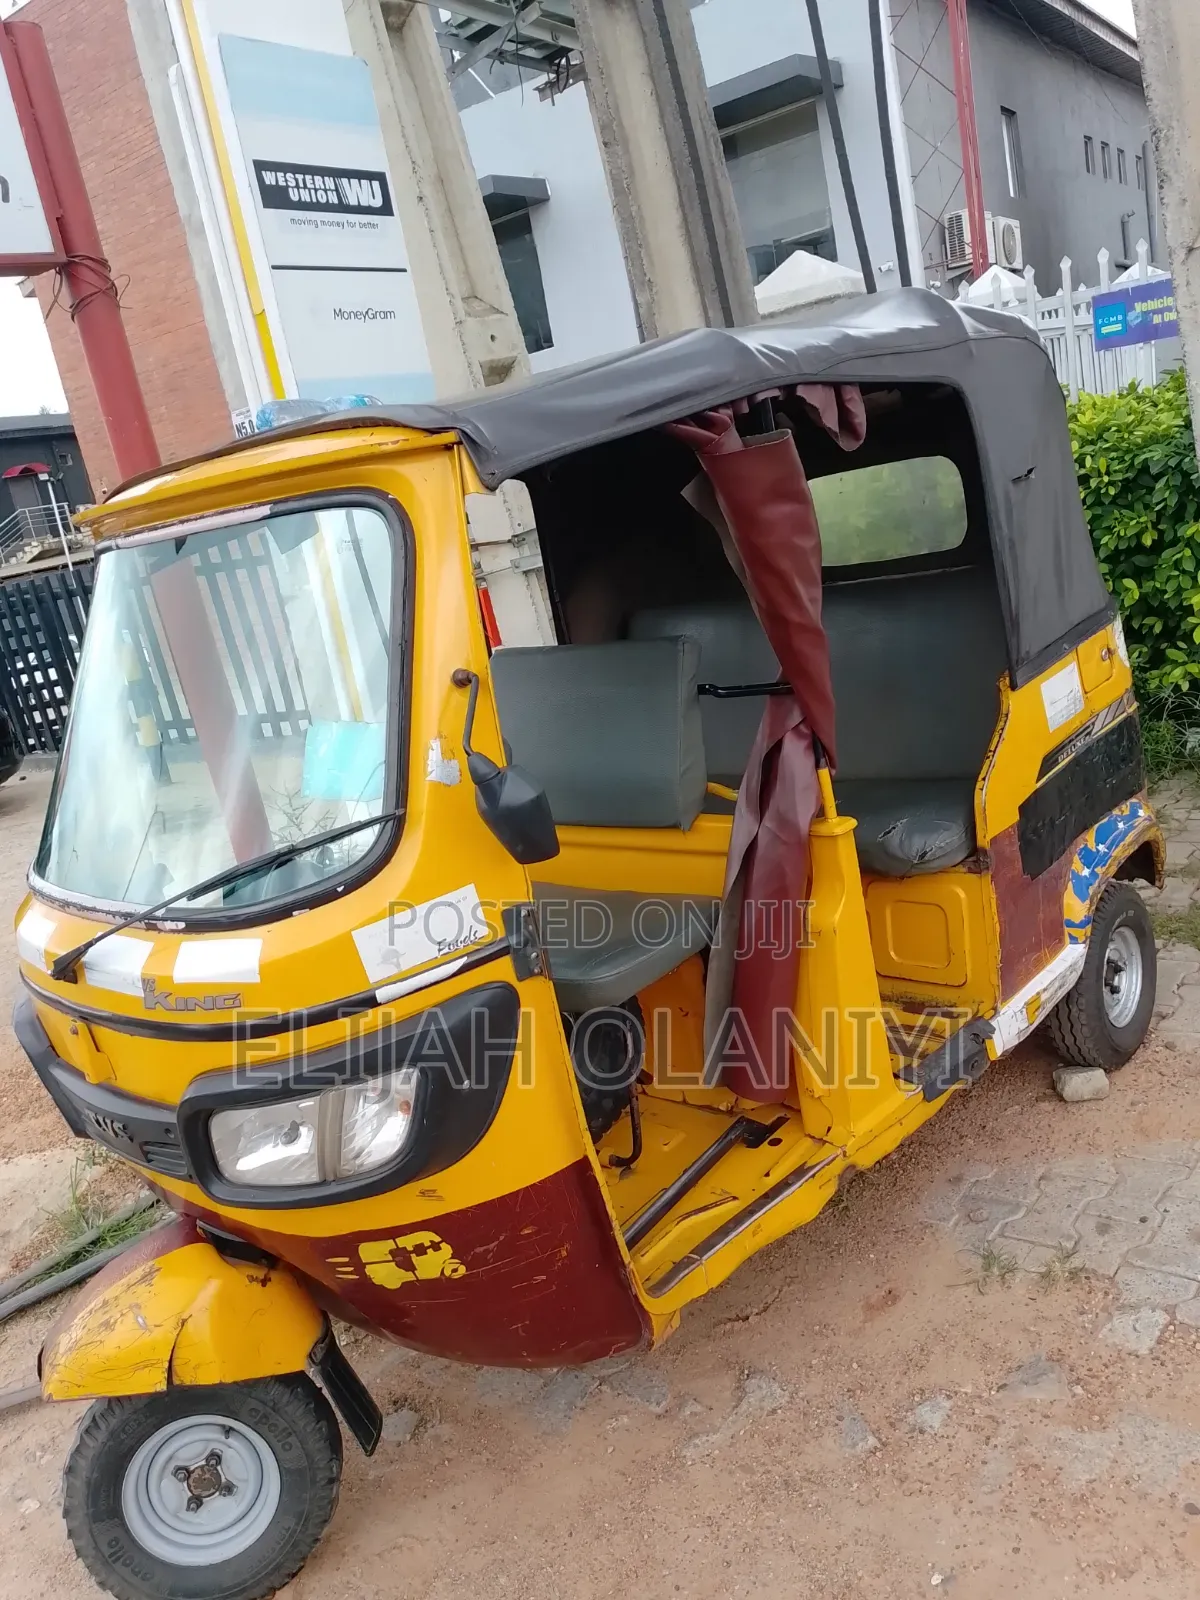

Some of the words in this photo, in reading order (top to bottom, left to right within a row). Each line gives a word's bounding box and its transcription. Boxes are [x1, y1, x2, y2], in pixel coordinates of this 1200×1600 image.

[261, 171, 336, 190] WESTERN
[341, 178, 383, 208] WU
[288, 188, 338, 204] UNION
[290, 217, 318, 228] moving
[320, 219, 344, 229] money
[346, 220, 357, 229] for
[359, 221, 379, 230] better
[333, 308, 396, 323] MoneyGram
[1098, 314, 1123, 325] FCMB
[1057, 735, 1087, 763] DELUXE
[436, 924, 482, 957] Foods
[144, 992, 242, 1012] KING
[247, 1406, 294, 1453] apollo
[107, 1536, 155, 1583] apollo
